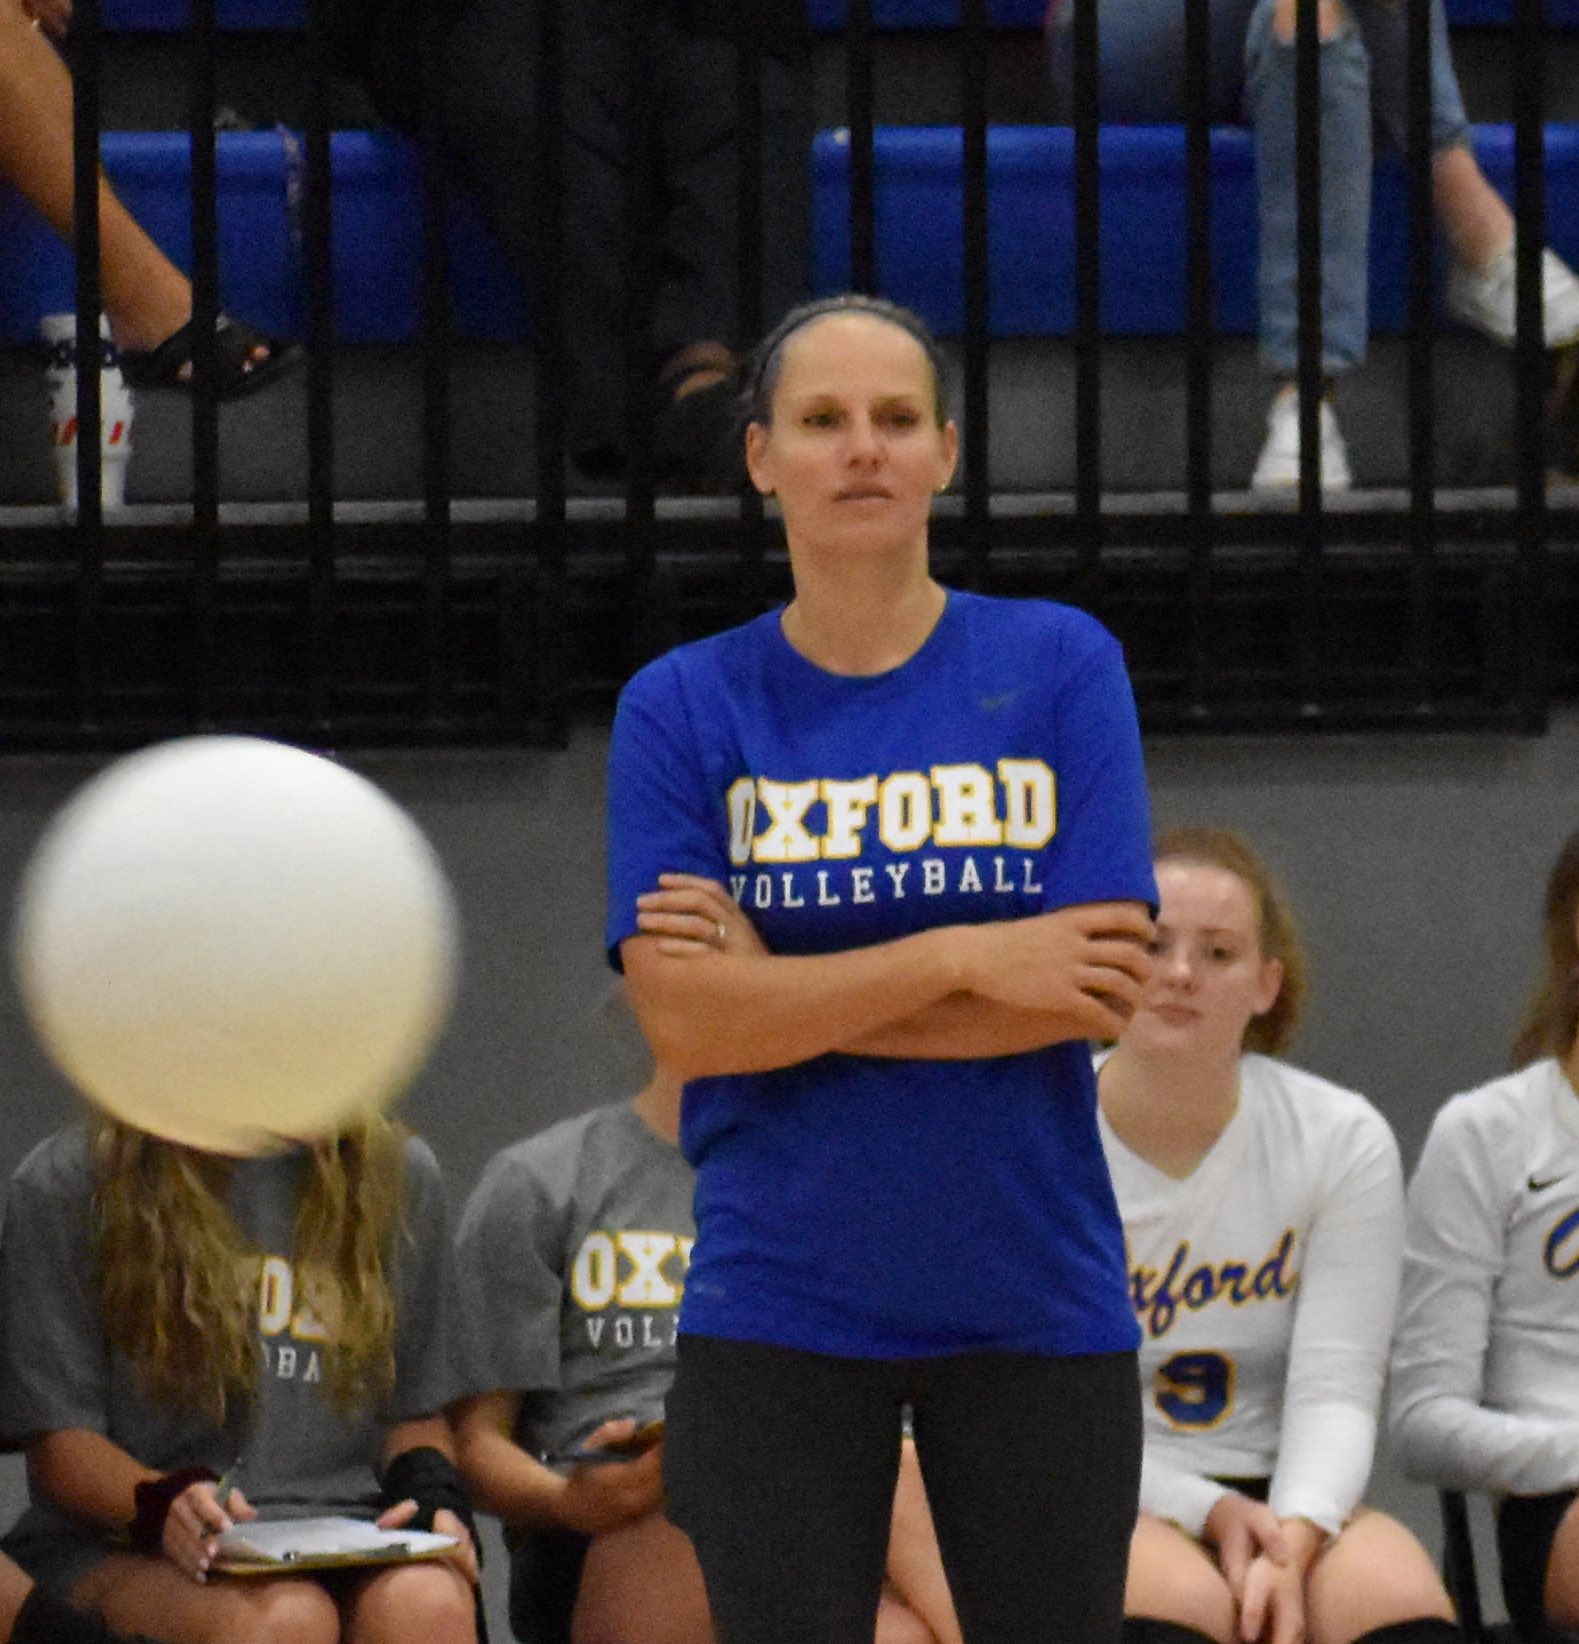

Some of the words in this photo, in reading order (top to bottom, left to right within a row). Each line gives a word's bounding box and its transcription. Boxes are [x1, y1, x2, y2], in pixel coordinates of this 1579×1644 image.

[726, 757, 1057, 867] OXFORD
[731, 856, 1043, 909] VOLLEYBALL
[570, 1229, 695, 1312] OX
[1127, 1226, 1298, 1339] xford
[261, 1342, 322, 1384] BA
[1153, 1350, 1236, 1431] 9
